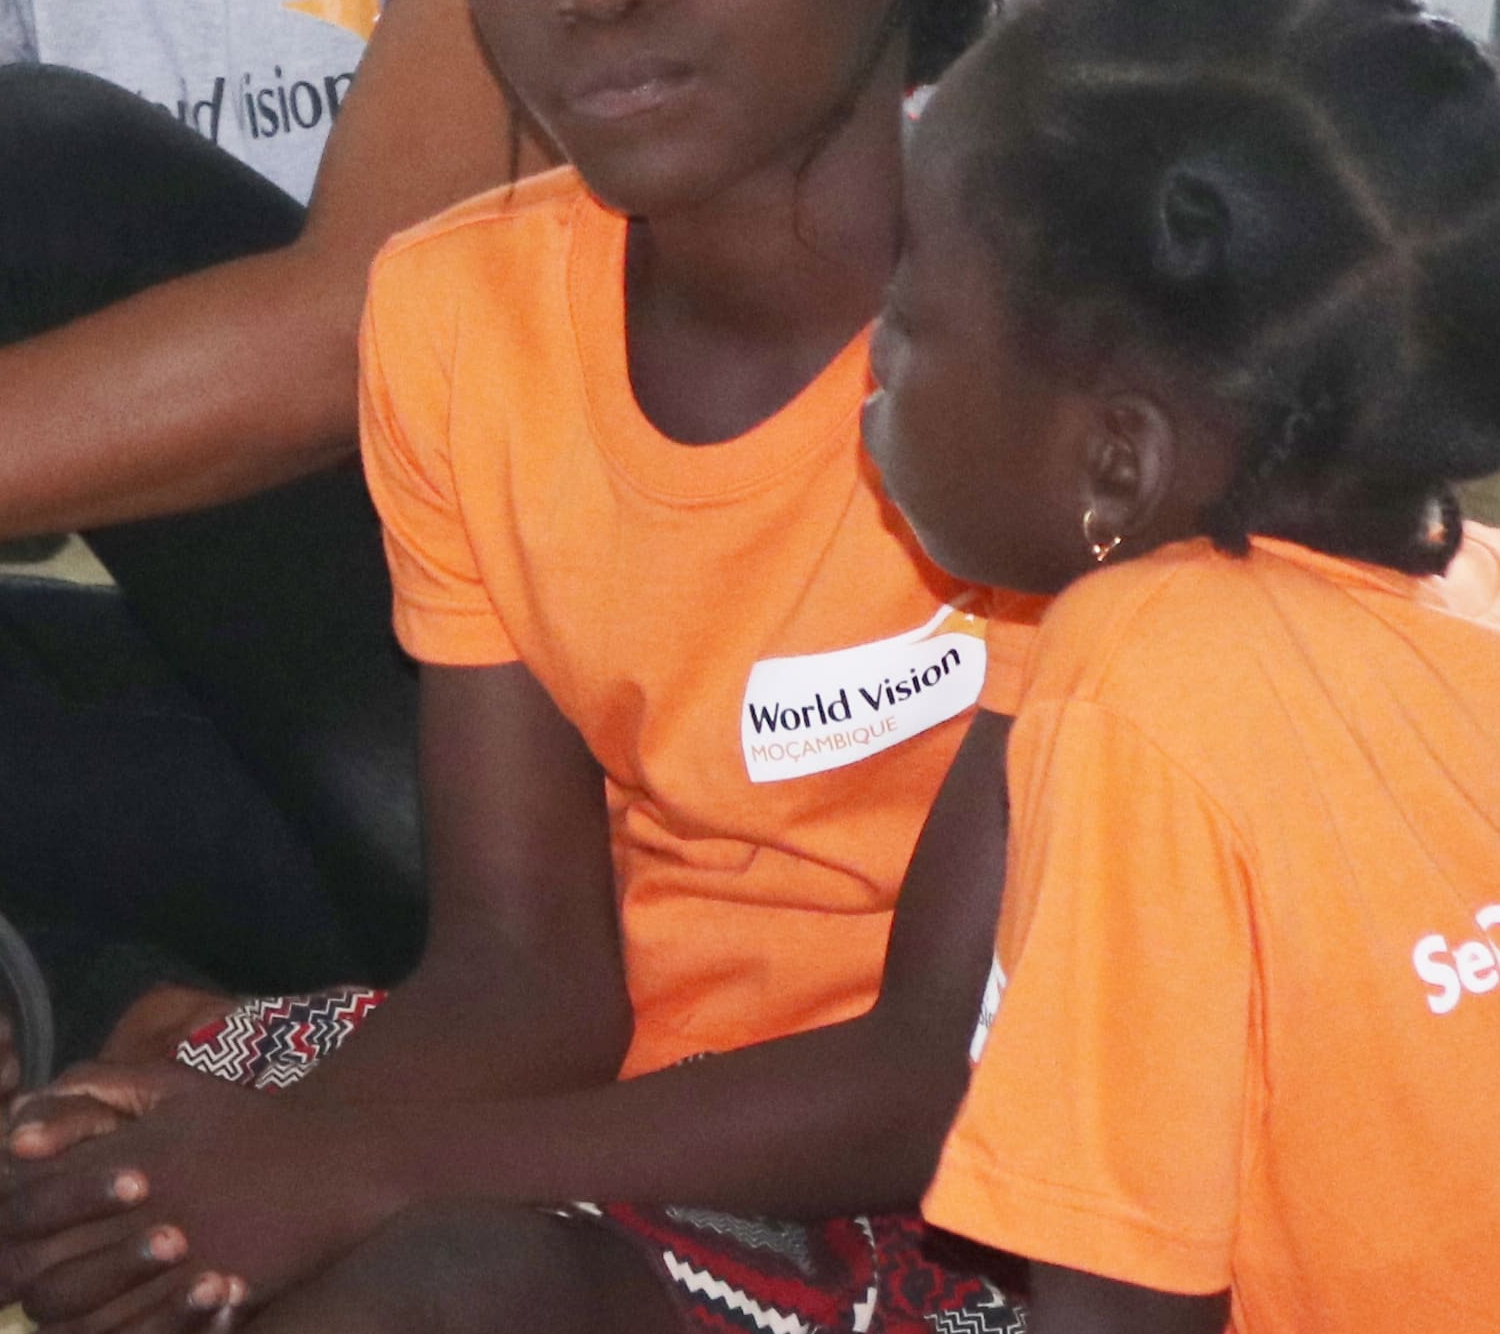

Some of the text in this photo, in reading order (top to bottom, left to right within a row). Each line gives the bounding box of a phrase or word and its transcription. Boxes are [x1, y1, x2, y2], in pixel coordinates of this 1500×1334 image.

[749, 647, 961, 734] World Vision
[750, 716, 899, 763] MOÇAMBIQUE
